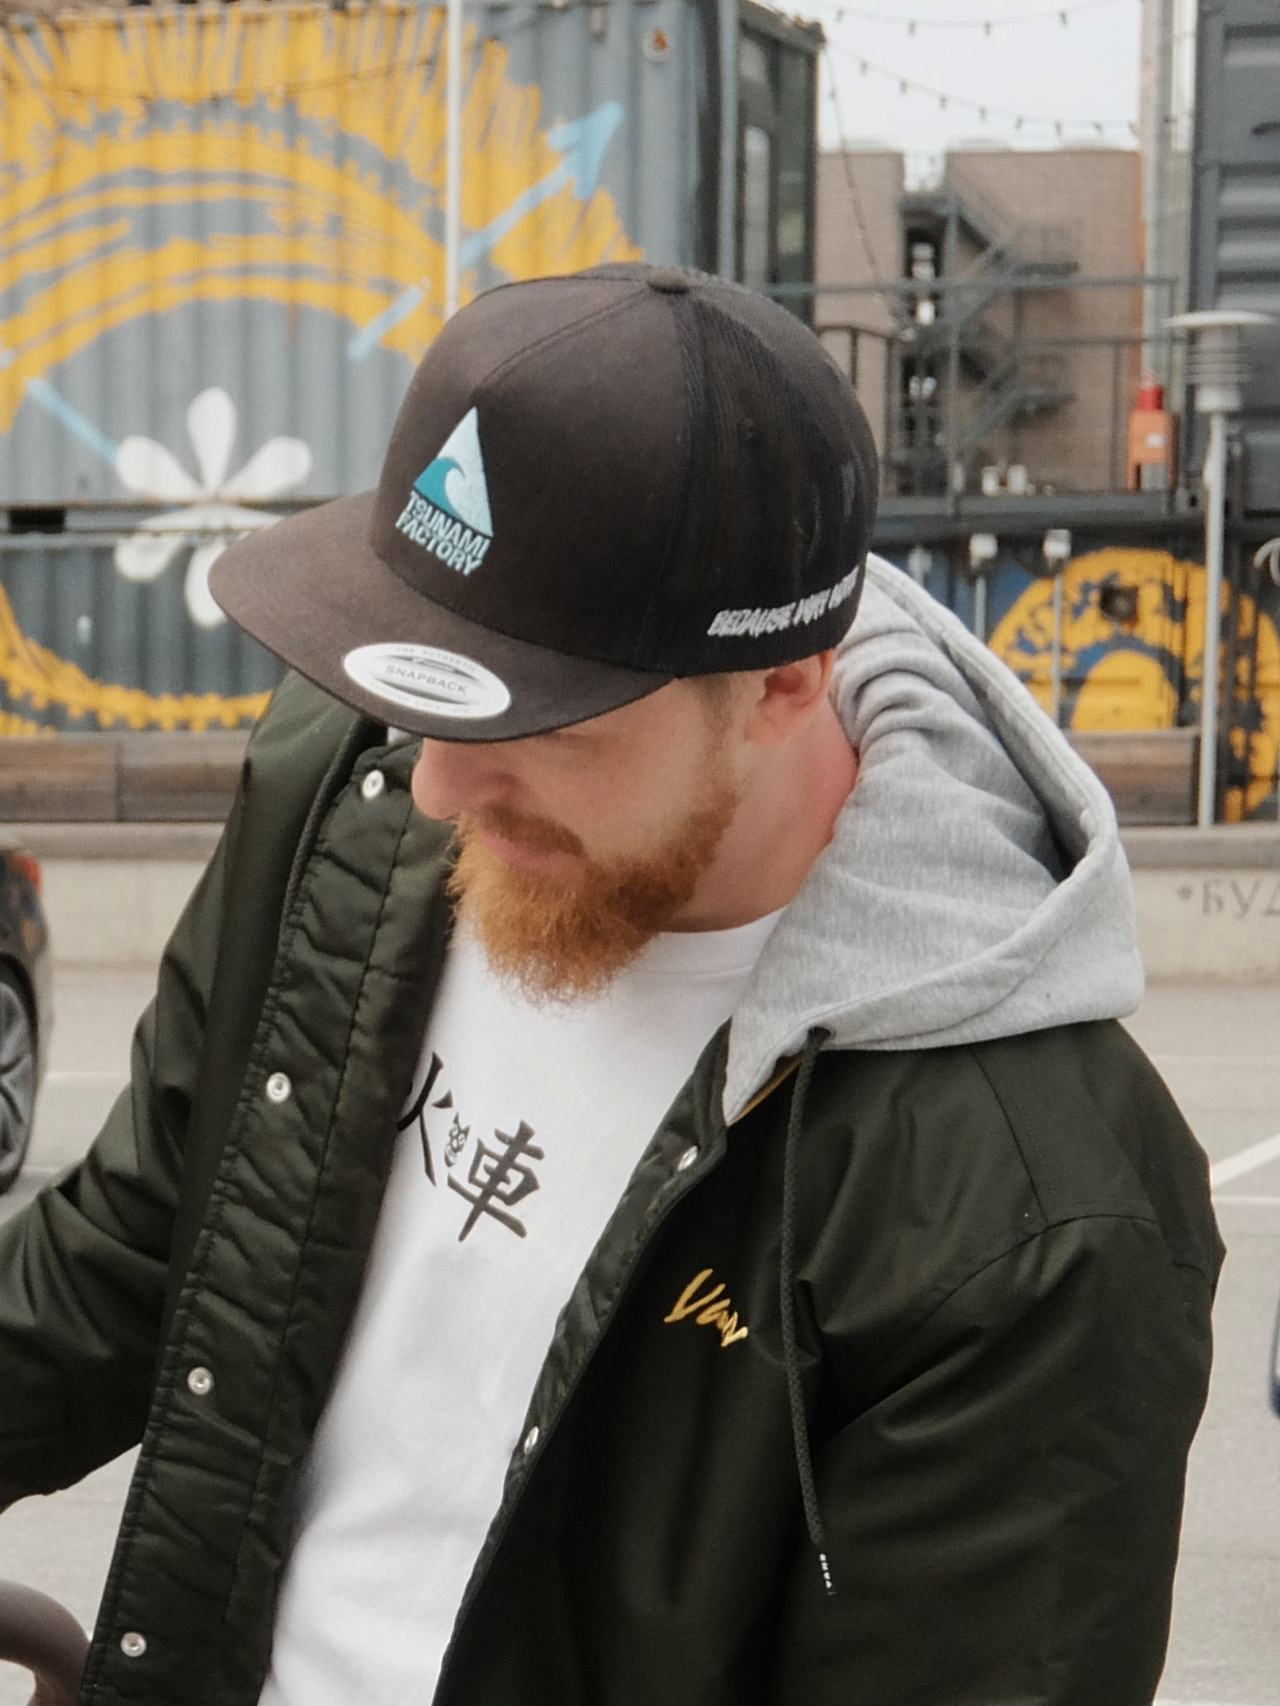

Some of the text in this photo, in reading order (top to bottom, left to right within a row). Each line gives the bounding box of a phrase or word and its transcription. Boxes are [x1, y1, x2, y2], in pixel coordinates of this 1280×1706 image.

[395, 510, 483, 576] FACTORY
[405, 489, 491, 559] TSUNAMI
[707, 602, 796, 638] BECAUSE
[385, 664, 469, 695] SNAPBACK
